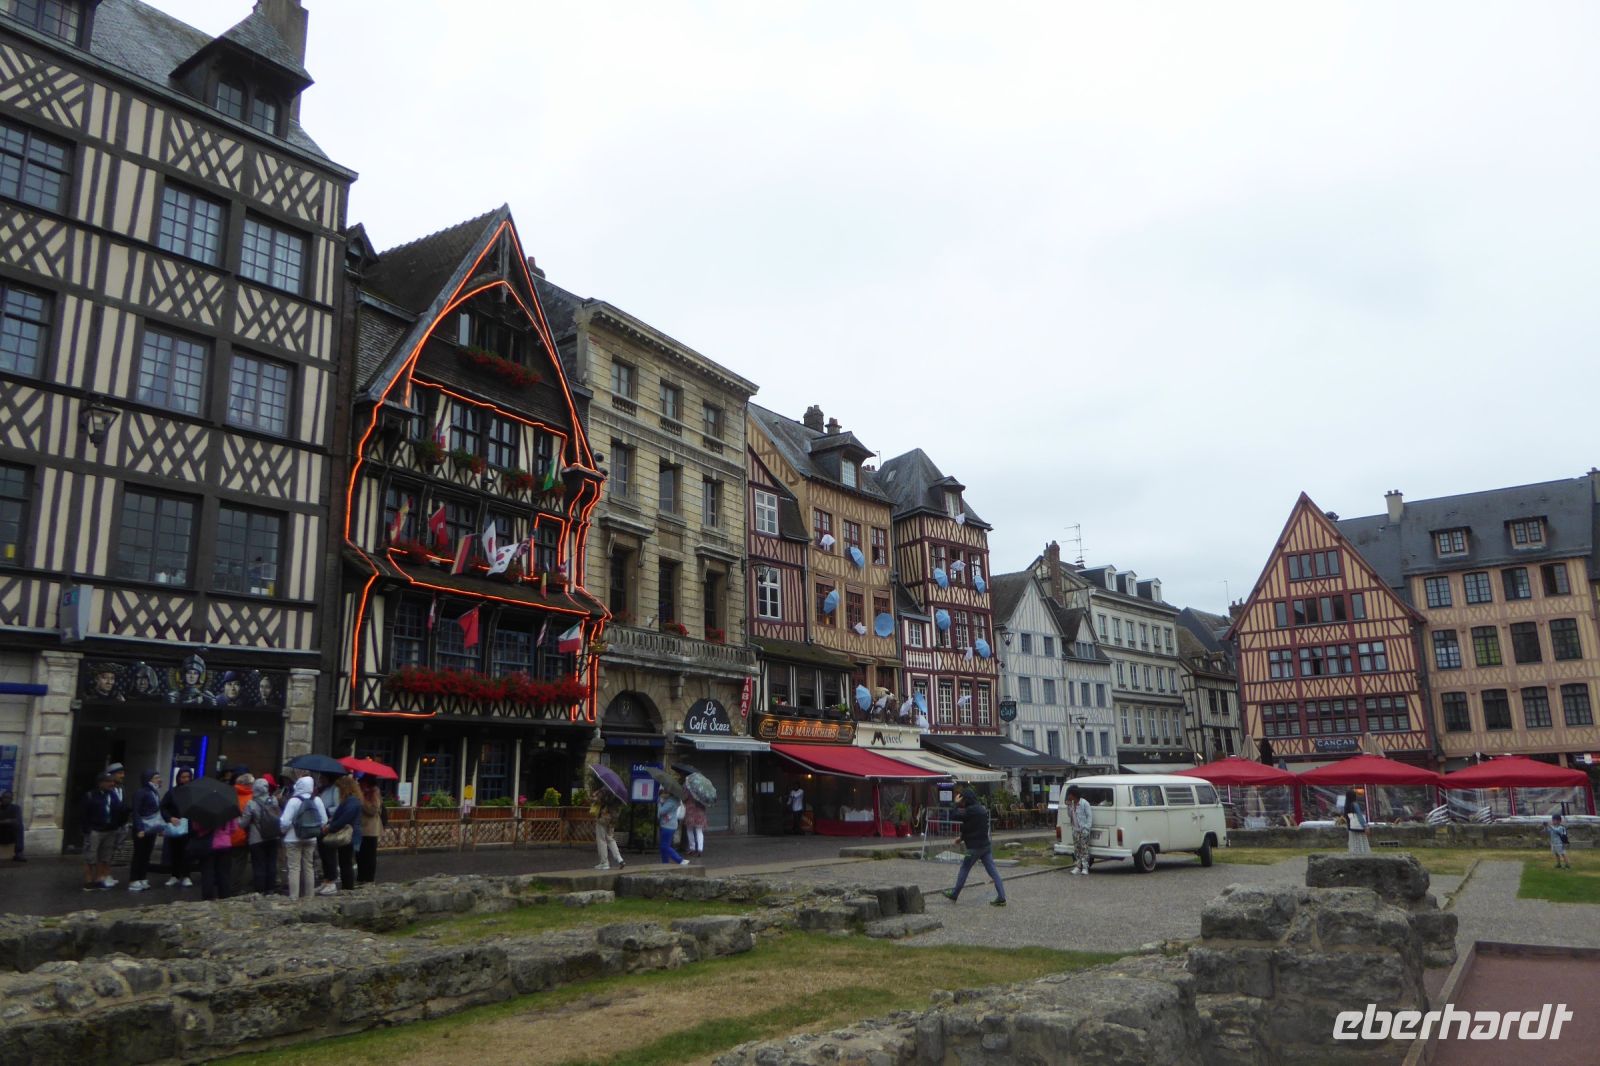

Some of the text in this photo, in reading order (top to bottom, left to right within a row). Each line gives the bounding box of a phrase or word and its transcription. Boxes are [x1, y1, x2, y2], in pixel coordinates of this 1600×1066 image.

[741, 677, 750, 716] TABAC
[703, 701, 717, 716] Le
[689, 716, 707, 733] Café
[780, 724, 794, 736] LES
[1317, 738, 1355, 747] CANCAN
